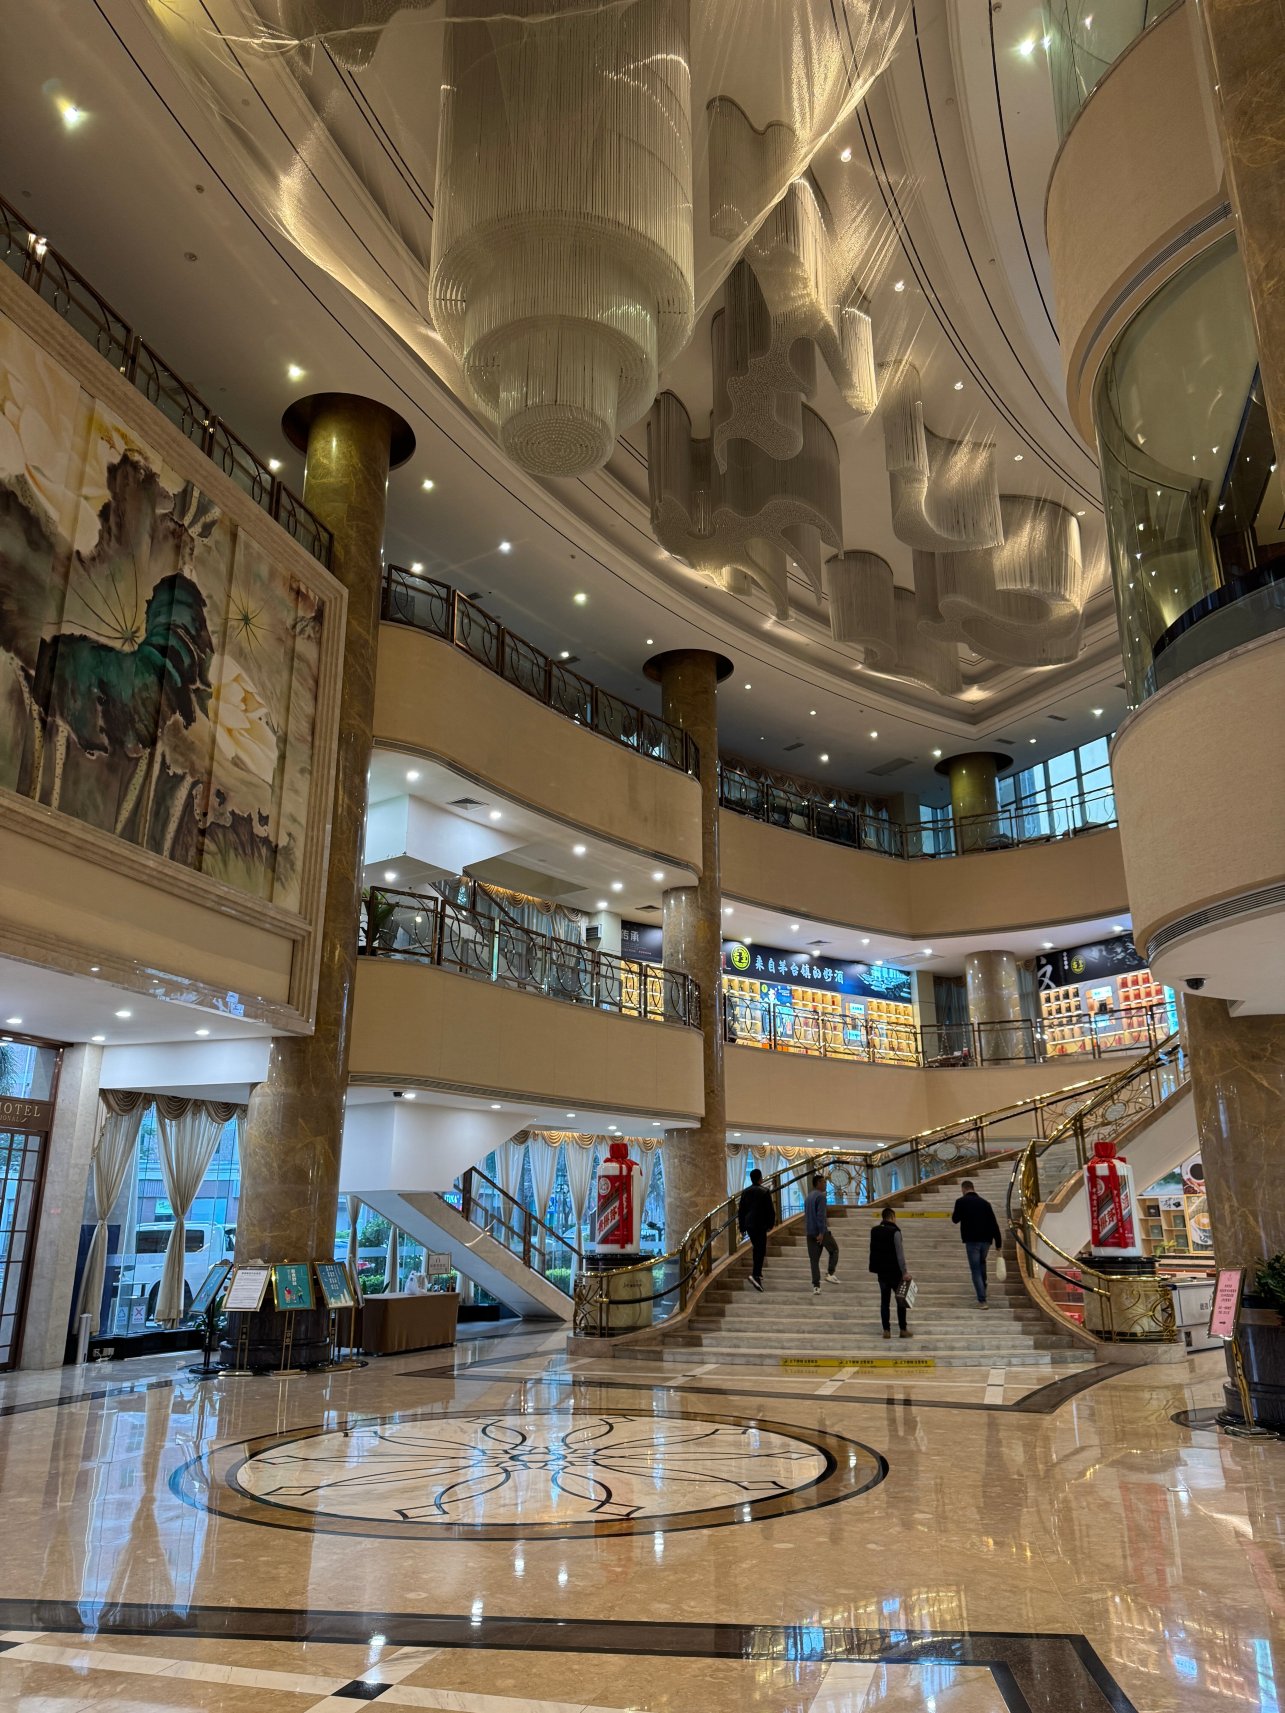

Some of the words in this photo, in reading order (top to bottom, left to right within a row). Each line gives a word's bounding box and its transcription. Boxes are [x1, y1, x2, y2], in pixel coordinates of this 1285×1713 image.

[755, 955, 844, 984] 来自茅台镇的好酒
[0, 1102, 41, 1117] OTEL
